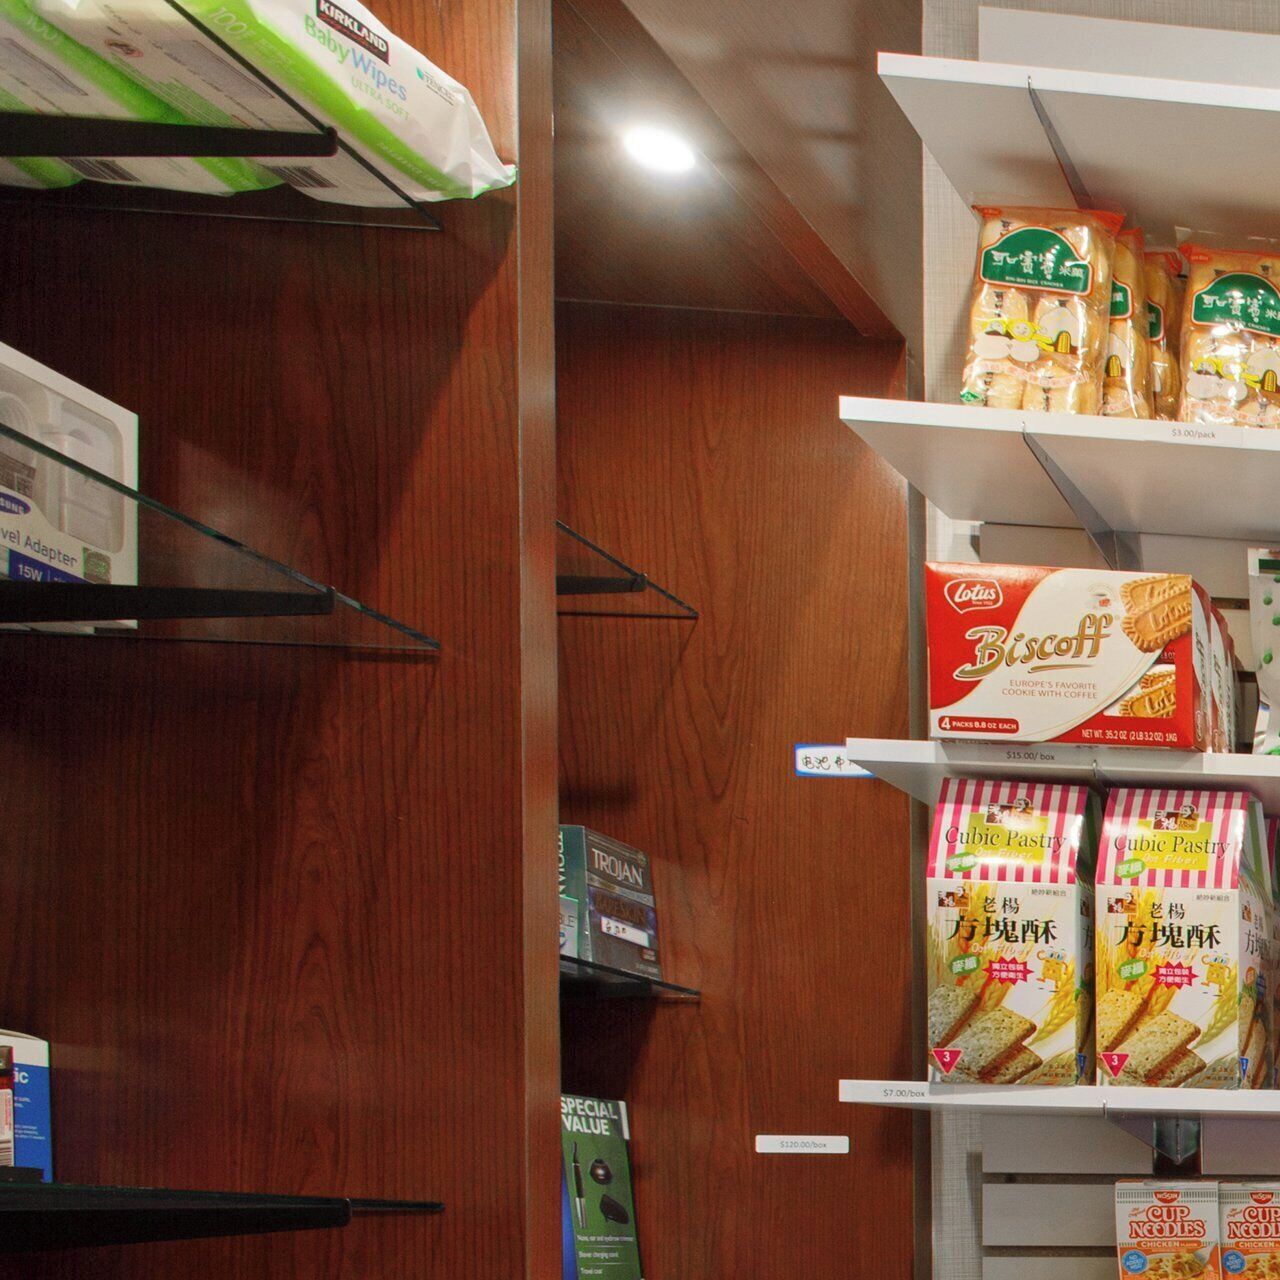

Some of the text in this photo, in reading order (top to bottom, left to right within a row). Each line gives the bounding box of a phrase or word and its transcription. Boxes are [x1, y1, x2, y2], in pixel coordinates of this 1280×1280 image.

[319, 0, 387, 52] KIRKLAND
[1171, 428, 1216, 439] $3.00/pack
[24, 536, 78, 567] Adapter
[18, 564, 43, 581] 15W
[954, 583, 997, 602] Lotus
[953, 613, 1114, 681] Biscoff
[1002, 688, 1098, 699] COOKIE WITH COFFEE
[1010, 679, 1097, 691] EUROPE'S FAVORITE
[941, 717, 951, 729] 4
[999, 722, 1017, 730] EACH
[1082, 729, 1092, 738] NET
[1040, 753, 1055, 761] box
[945, 826, 1069, 854] Cubic Pastry
[1114, 836, 1230, 858] Cubic Pastry
[592, 848, 643, 888] TROJAN
[982, 897, 1020, 914] 老楊
[1150, 902, 1186, 920] 老楊
[945, 916, 1057, 945] 方塊酥
[1116, 922, 1222, 949] 方塊酥
[883, 1088, 925, 1098] $7.00/box
[561, 1096, 618, 1119] SPECIAL
[561, 1114, 610, 1135] VALUE
[780, 1140, 827, 1150] $120.00/box
[1147, 1206, 1190, 1222] CUP
[1130, 1221, 1206, 1239] NOODLES
